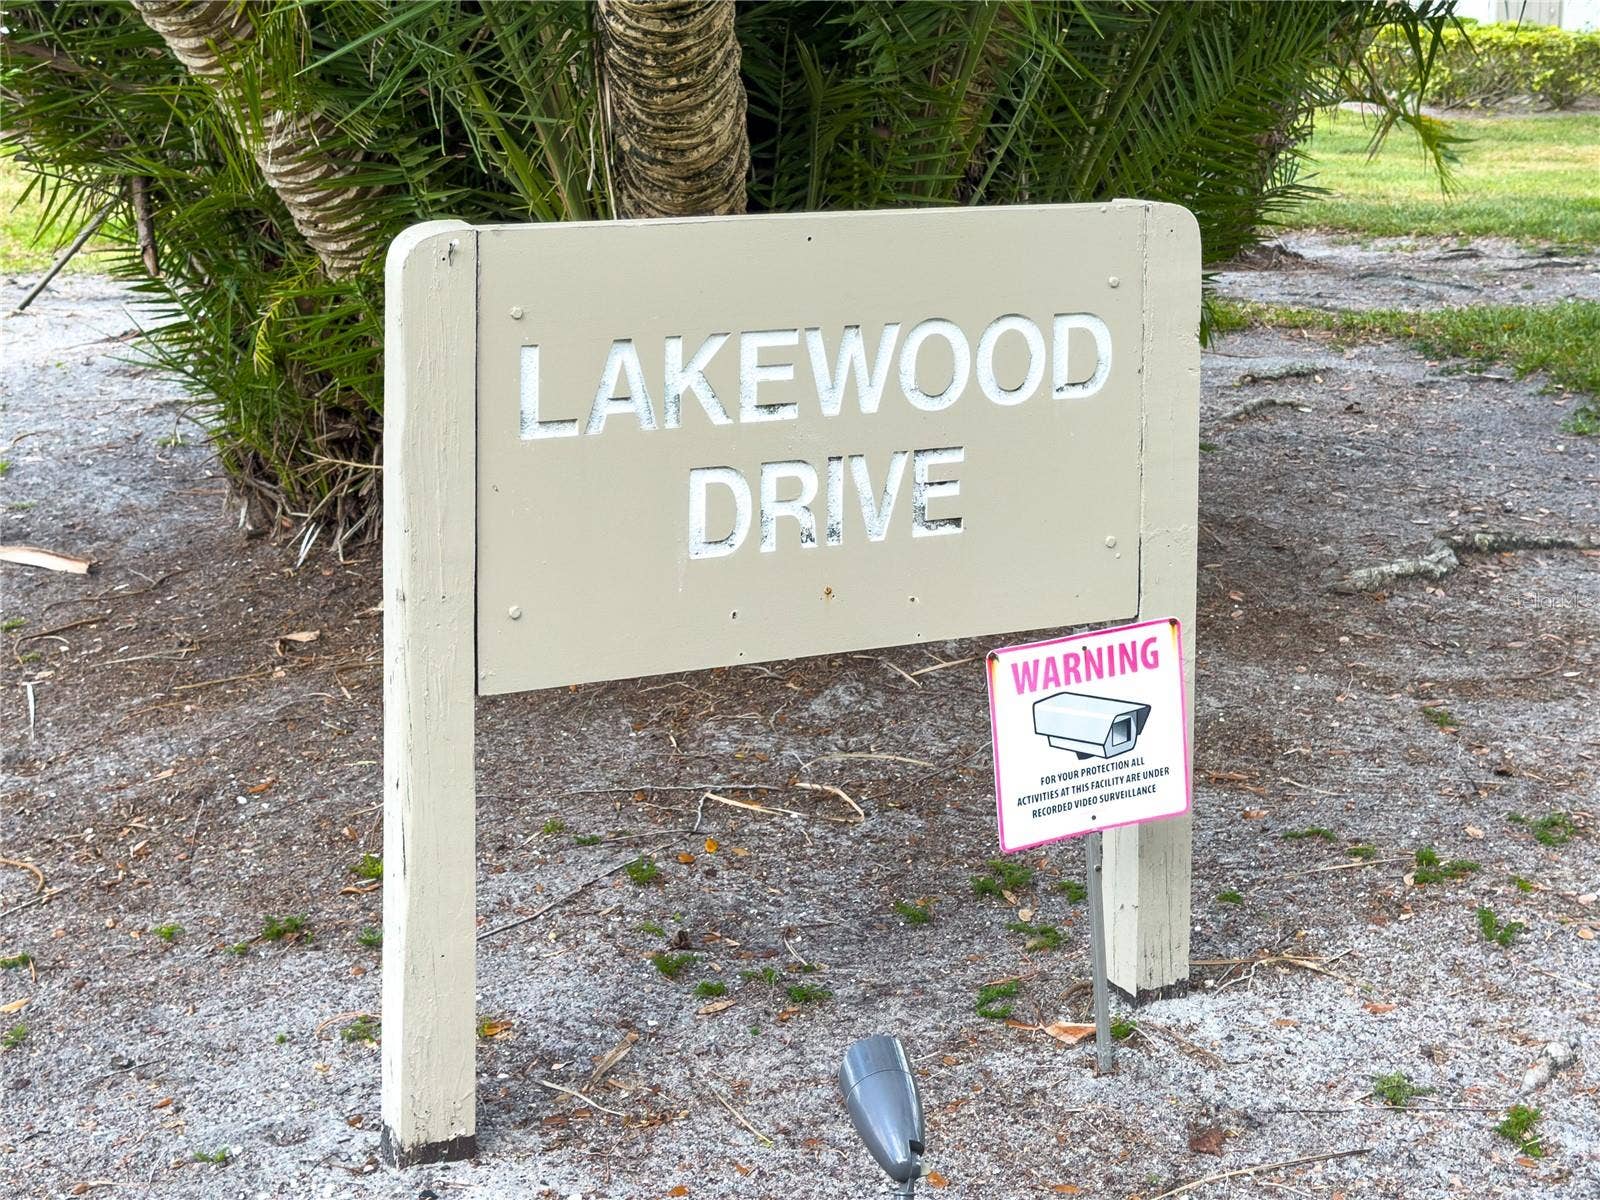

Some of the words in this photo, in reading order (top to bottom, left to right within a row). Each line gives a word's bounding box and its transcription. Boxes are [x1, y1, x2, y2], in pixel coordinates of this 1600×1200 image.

[520, 312, 1113, 440] LAKEWOOD
[688, 446, 965, 559] DRIVE
[1011, 637, 1159, 695] WARNING
[1017, 789, 1059, 807] ACTIVITIES
[1060, 786, 1070, 797] AT
[1071, 781, 1089, 795] THIS
[1090, 776, 1125, 790] FACILITY
[1126, 772, 1141, 783] ARE
[1142, 767, 1170, 780] UNDER
[1040, 773, 1056, 786] FOR
[1057, 770, 1079, 783] YOUR
[1081, 759, 1129, 778] PROTECTION
[1131, 757, 1145, 767] ALL
[1032, 802, 1073, 819] RECORDED
[1074, 796, 1098, 809] VIDEO
[1099, 784, 1156, 804] SURVEILLANCE
